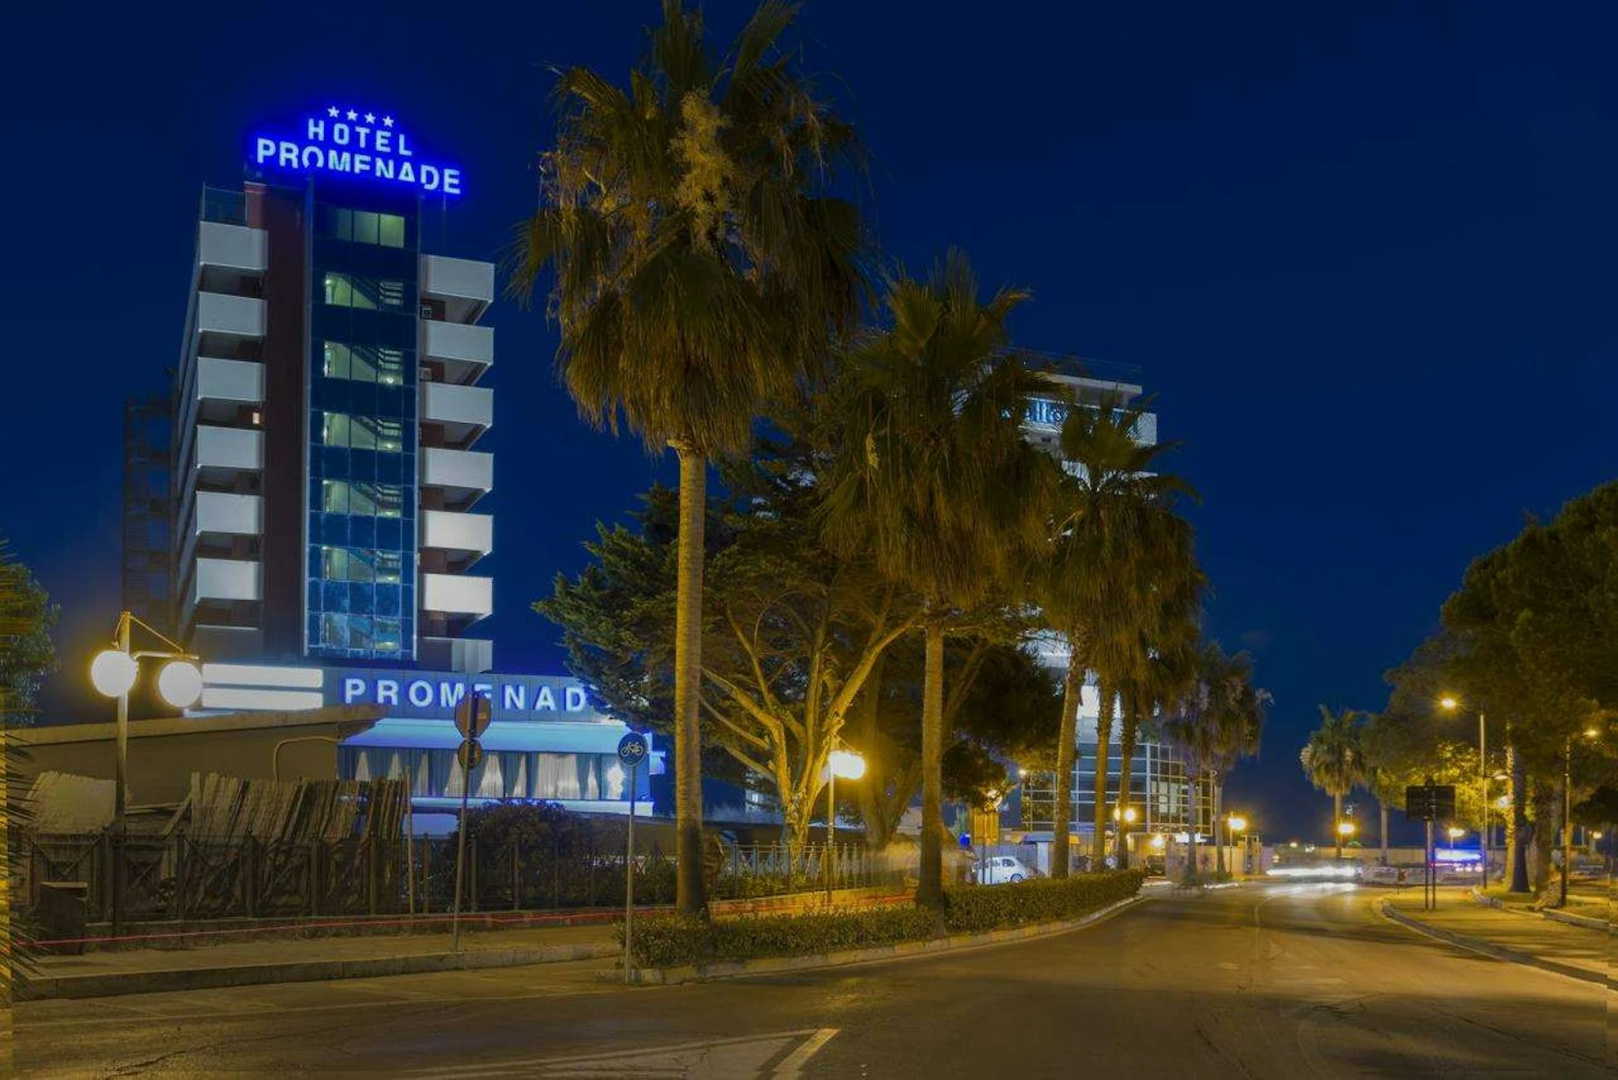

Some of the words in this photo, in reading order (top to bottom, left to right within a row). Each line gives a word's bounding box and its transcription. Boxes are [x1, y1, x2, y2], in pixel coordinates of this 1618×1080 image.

[308, 118, 412, 156] HOTEL
[257, 137, 461, 194] PROMENADE
[345, 678, 610, 711] PROMNAD
